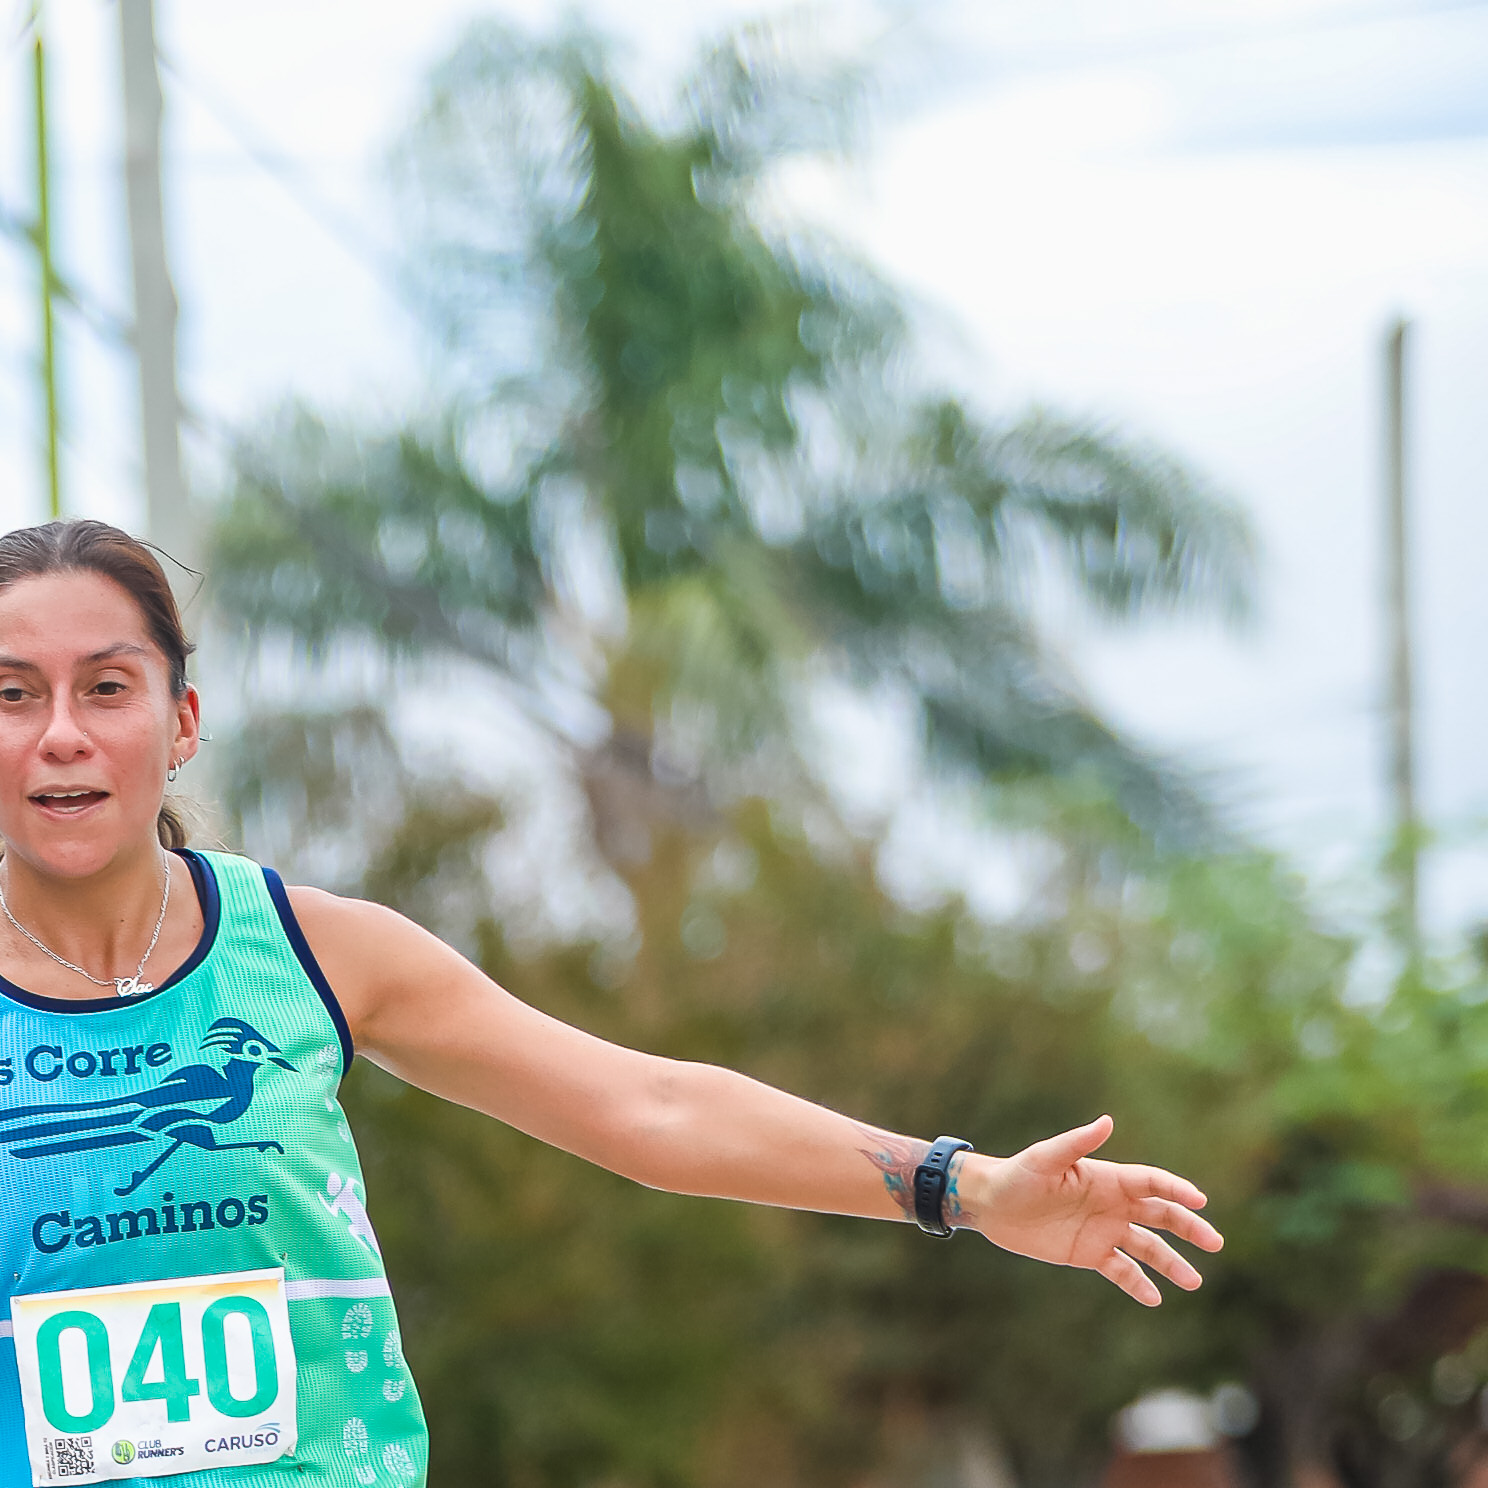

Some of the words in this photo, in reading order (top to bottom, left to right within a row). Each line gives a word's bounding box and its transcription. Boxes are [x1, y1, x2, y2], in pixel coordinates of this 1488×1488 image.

[25, 1042, 172, 1082] Corre
[32, 1192, 269, 1254] Caminos
[36, 1296, 279, 1433] 040
[137, 1439, 162, 1450] CLUB
[137, 1447, 185, 1460] RUNNER'S
[204, 1432, 278, 1453] CARUSO
